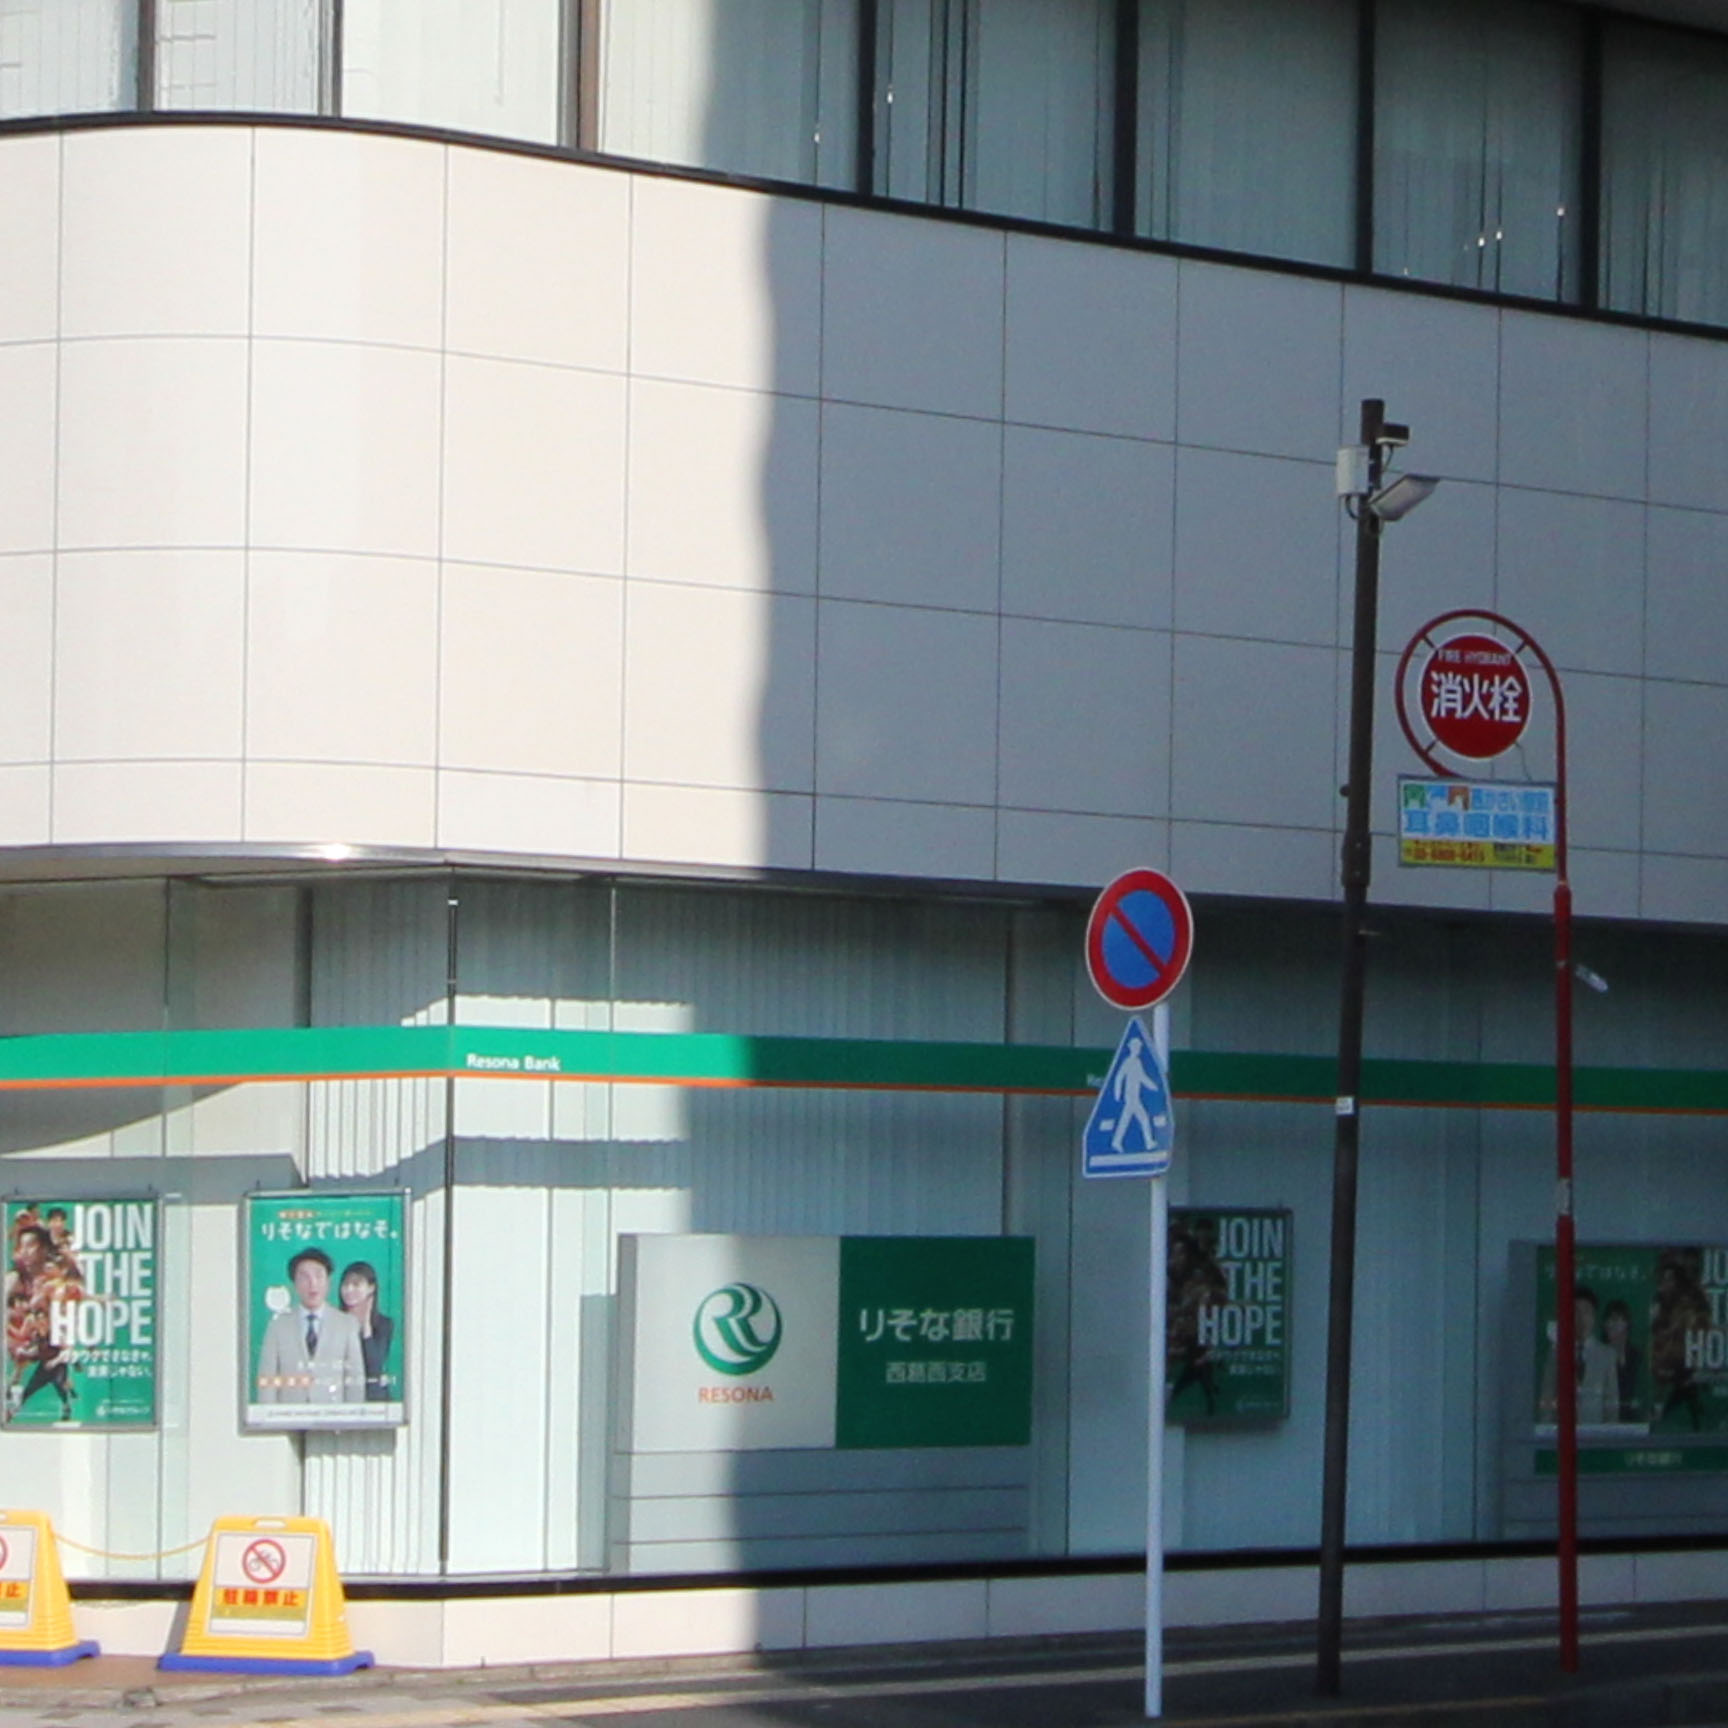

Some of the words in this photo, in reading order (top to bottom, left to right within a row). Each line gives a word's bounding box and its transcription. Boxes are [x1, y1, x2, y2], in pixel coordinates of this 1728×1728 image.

[1430, 670, 1522, 722] 消火栓
[467, 1053, 520, 1070] Resona
[524, 1055, 561, 1072] Bank
[70, 1204, 152, 1251] JOIN
[1216, 1218, 1283, 1259] JOIN
[78, 1252, 152, 1297] THE
[1221, 1261, 1283, 1302] THE
[50, 1300, 152, 1347] HOPE
[860, 1308, 1015, 1342] りそな銀行
[1197, 1304, 1282, 1346] HOPE
[885, 1361, 987, 1384] 西葛西支店
[698, 1386, 774, 1403] RESONA
[223, 1588, 299, 1607] 駐輪禁止
